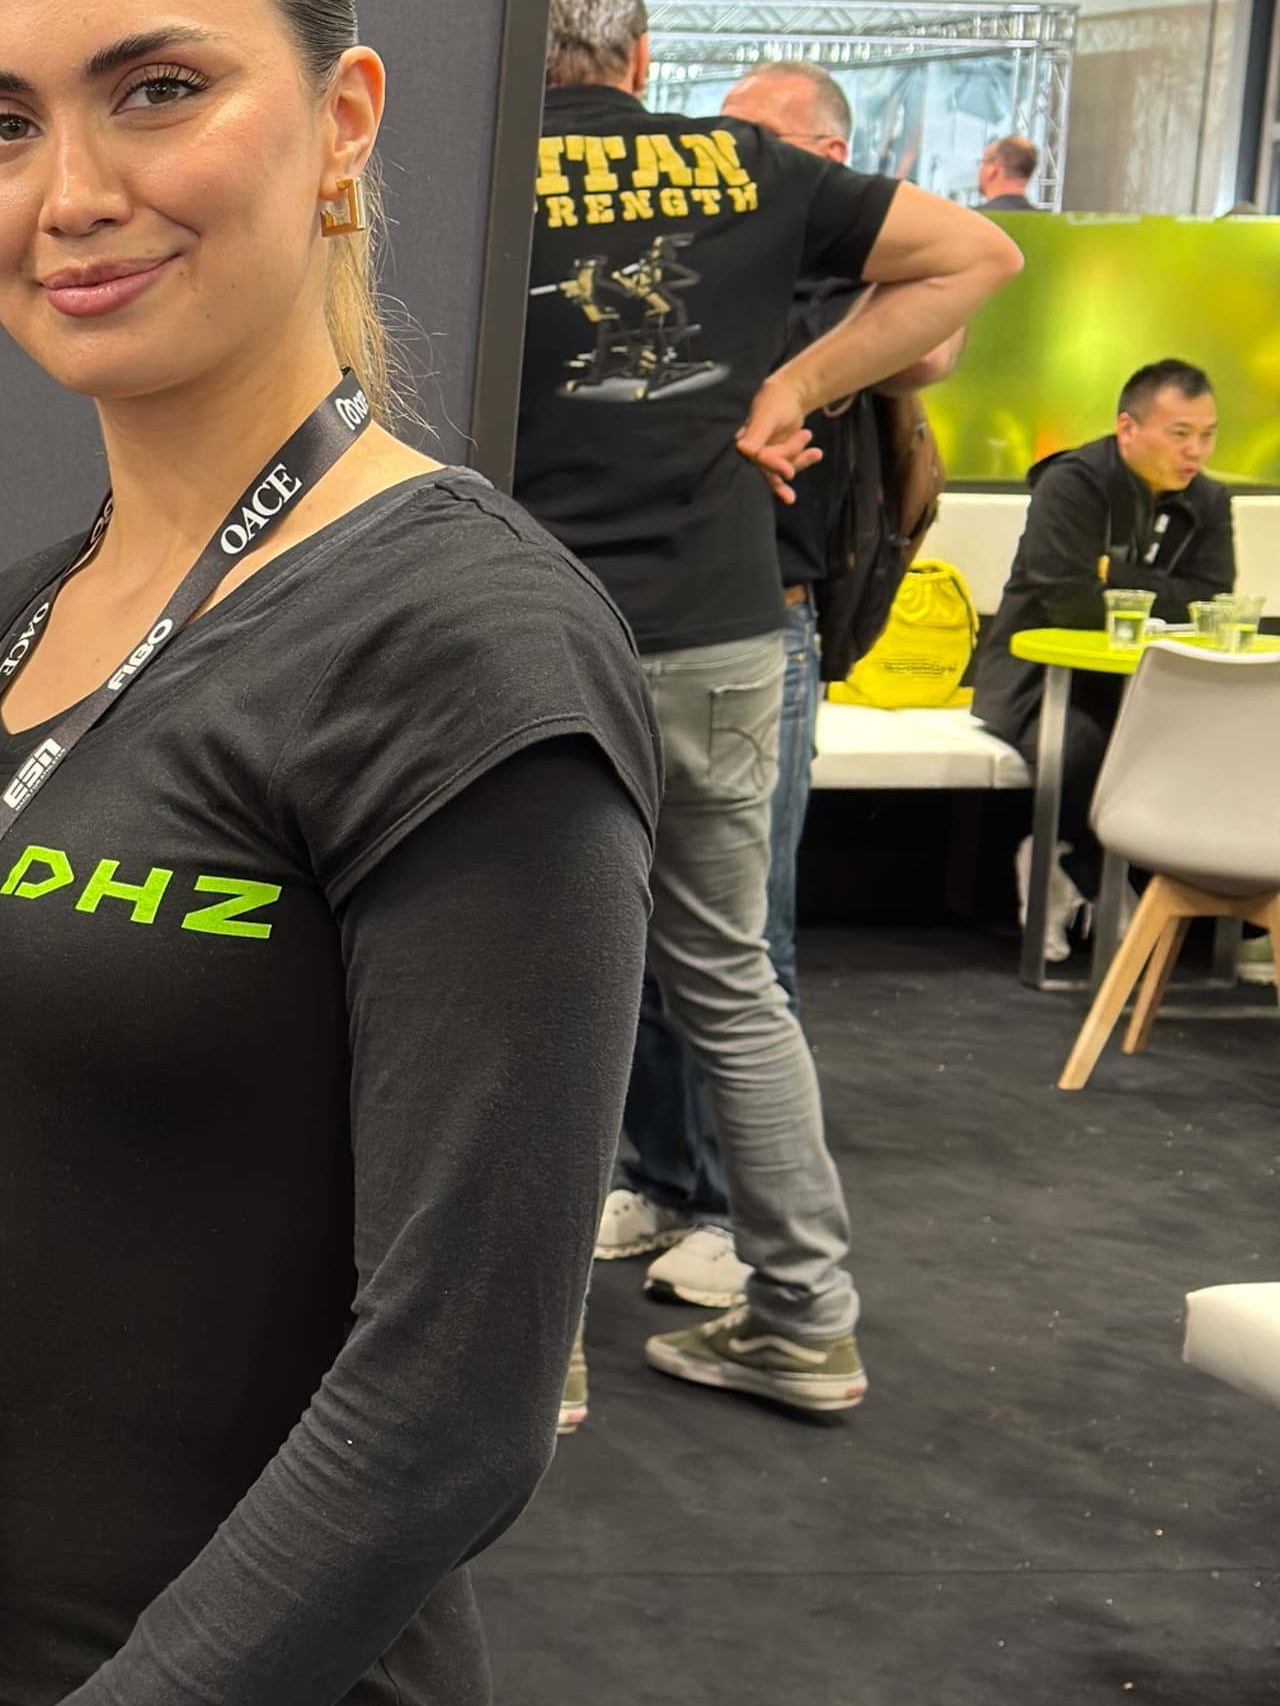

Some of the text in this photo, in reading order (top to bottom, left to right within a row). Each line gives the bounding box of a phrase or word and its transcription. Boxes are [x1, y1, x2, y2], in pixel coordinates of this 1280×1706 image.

[536, 130, 750, 195] ITAN
[220, 464, 302, 556] OACE
[107, 618, 173, 691] FIBO
[3, 738, 61, 808] ESN
[0, 844, 282, 940] DHZ
